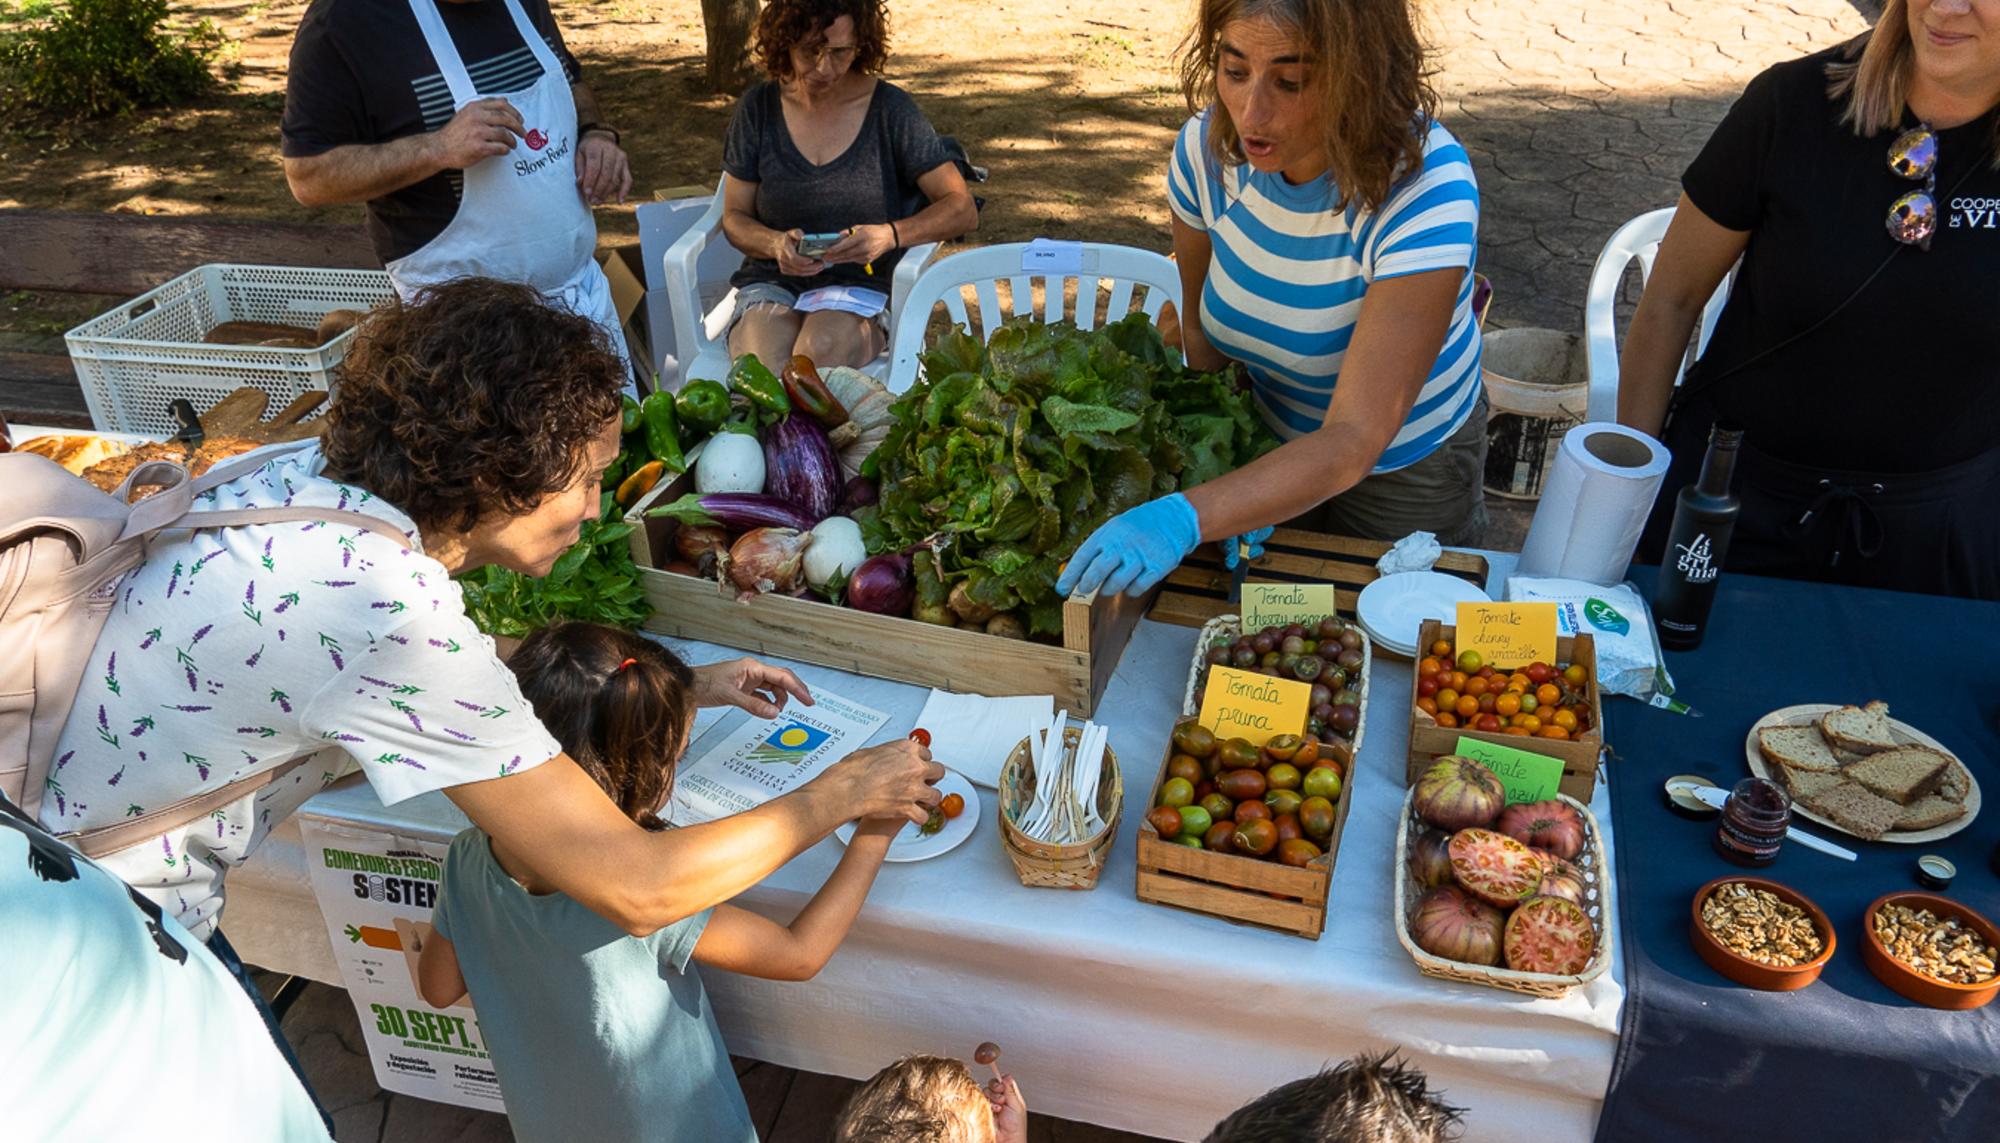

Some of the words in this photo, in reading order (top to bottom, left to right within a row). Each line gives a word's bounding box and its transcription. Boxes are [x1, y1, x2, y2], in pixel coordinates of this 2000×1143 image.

[514, 157, 546, 177] Slow
[1949, 214, 1962, 227] DE
[1964, 209, 2000, 228] VI
[1254, 584, 1308, 605] Tomate
[1477, 608, 1522, 626] Tomate
[786, 708, 846, 738] AGRICULTURA
[1213, 706, 1273, 733] pruna
[722, 760, 784, 792] VALENCIANA
[1508, 784, 1545, 803] azul
[323, 848, 402, 875] COMEDORES
[370, 1003, 409, 1038] 30
[406, 1009, 478, 1050] SEPT.
